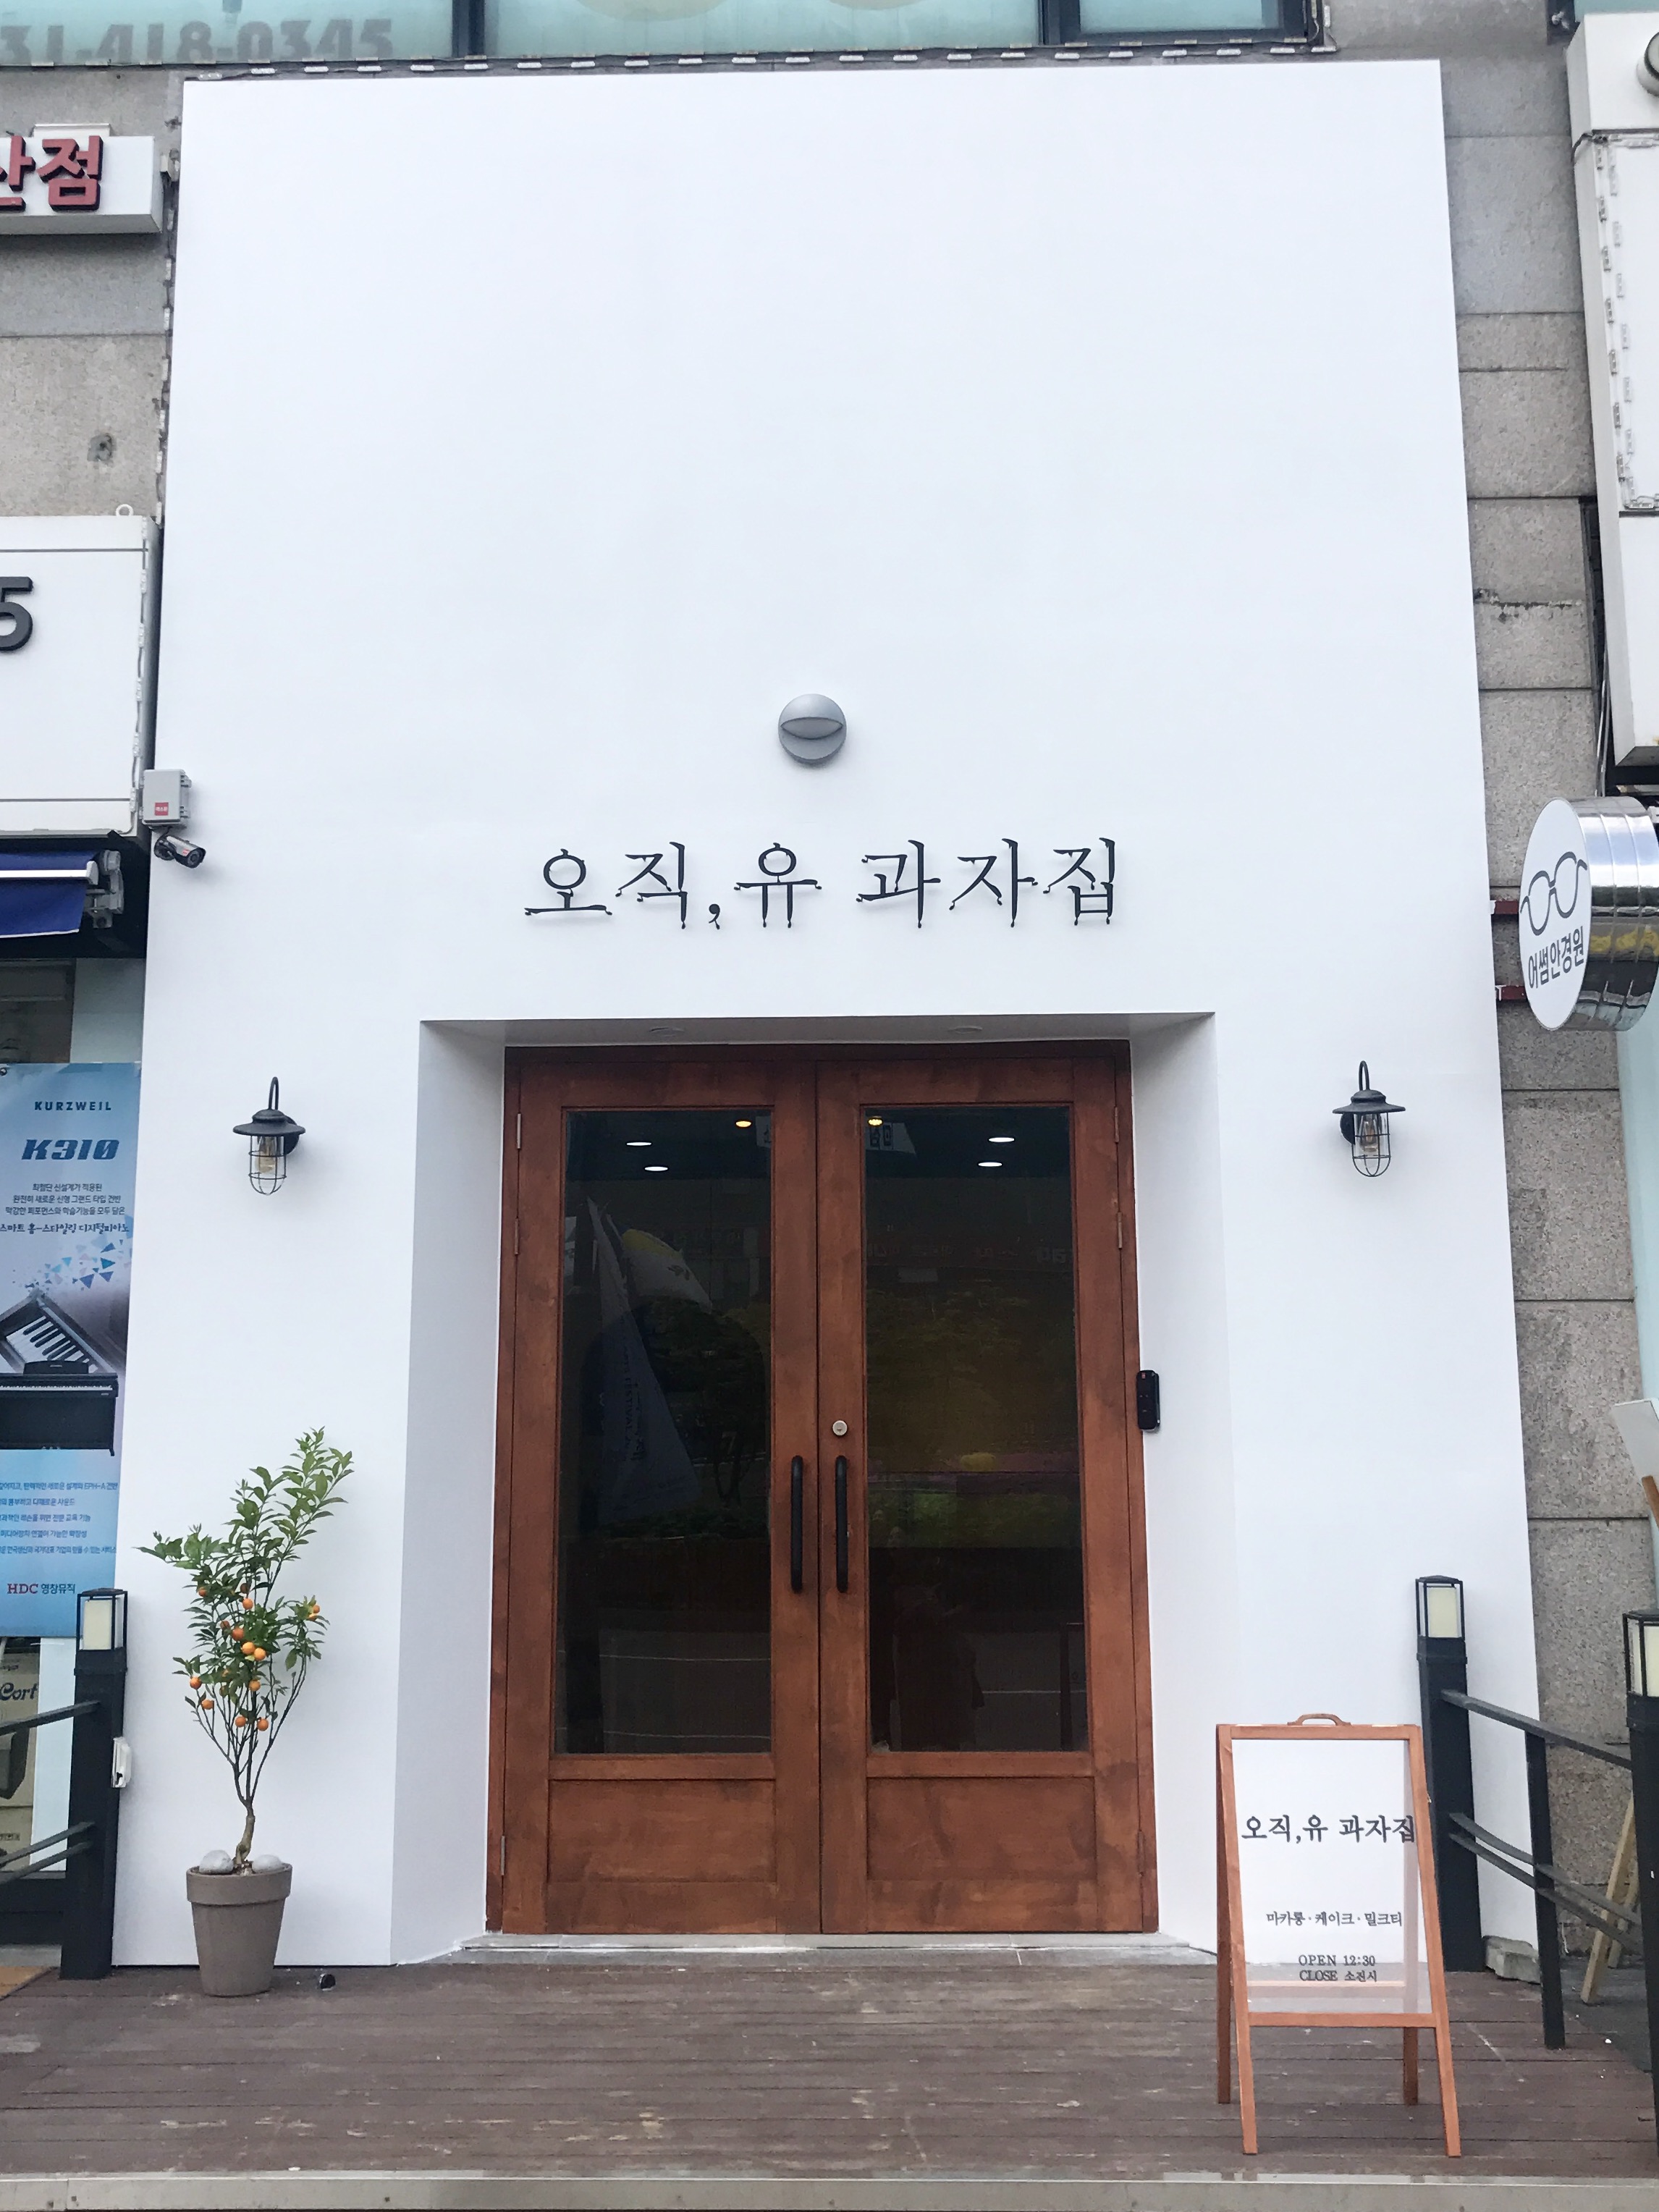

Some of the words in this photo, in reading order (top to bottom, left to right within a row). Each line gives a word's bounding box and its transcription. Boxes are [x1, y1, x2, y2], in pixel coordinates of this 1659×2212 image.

[524, 841, 823, 929] 오직,유
[856, 837, 1116, 929] 과자집
[1528, 926, 1584, 989] 어썸안경원
[35, 1101, 111, 1111] KURZWEIL
[21, 1139, 119, 1160] K310
[35, 1195, 55, 1204] 새로운
[72, 1195, 91, 1204] 그랜드
[97, 1207, 110, 1215] 모두
[0, 1223, 25, 1235] 스마트
[79, 1223, 129, 1235] 디지털피아노
[7, 1583, 38, 1594] HDC
[41, 1583, 75, 1595] 영창뮤직
[1241, 1815, 1328, 1844] 오직,유
[1339, 1815, 1415, 1844] 과자집
[1298, 1954, 1337, 1967] OPEN
[1343, 1954, 1376, 1967] 12:30
[1299, 1970, 1338, 1982] CLOSE
